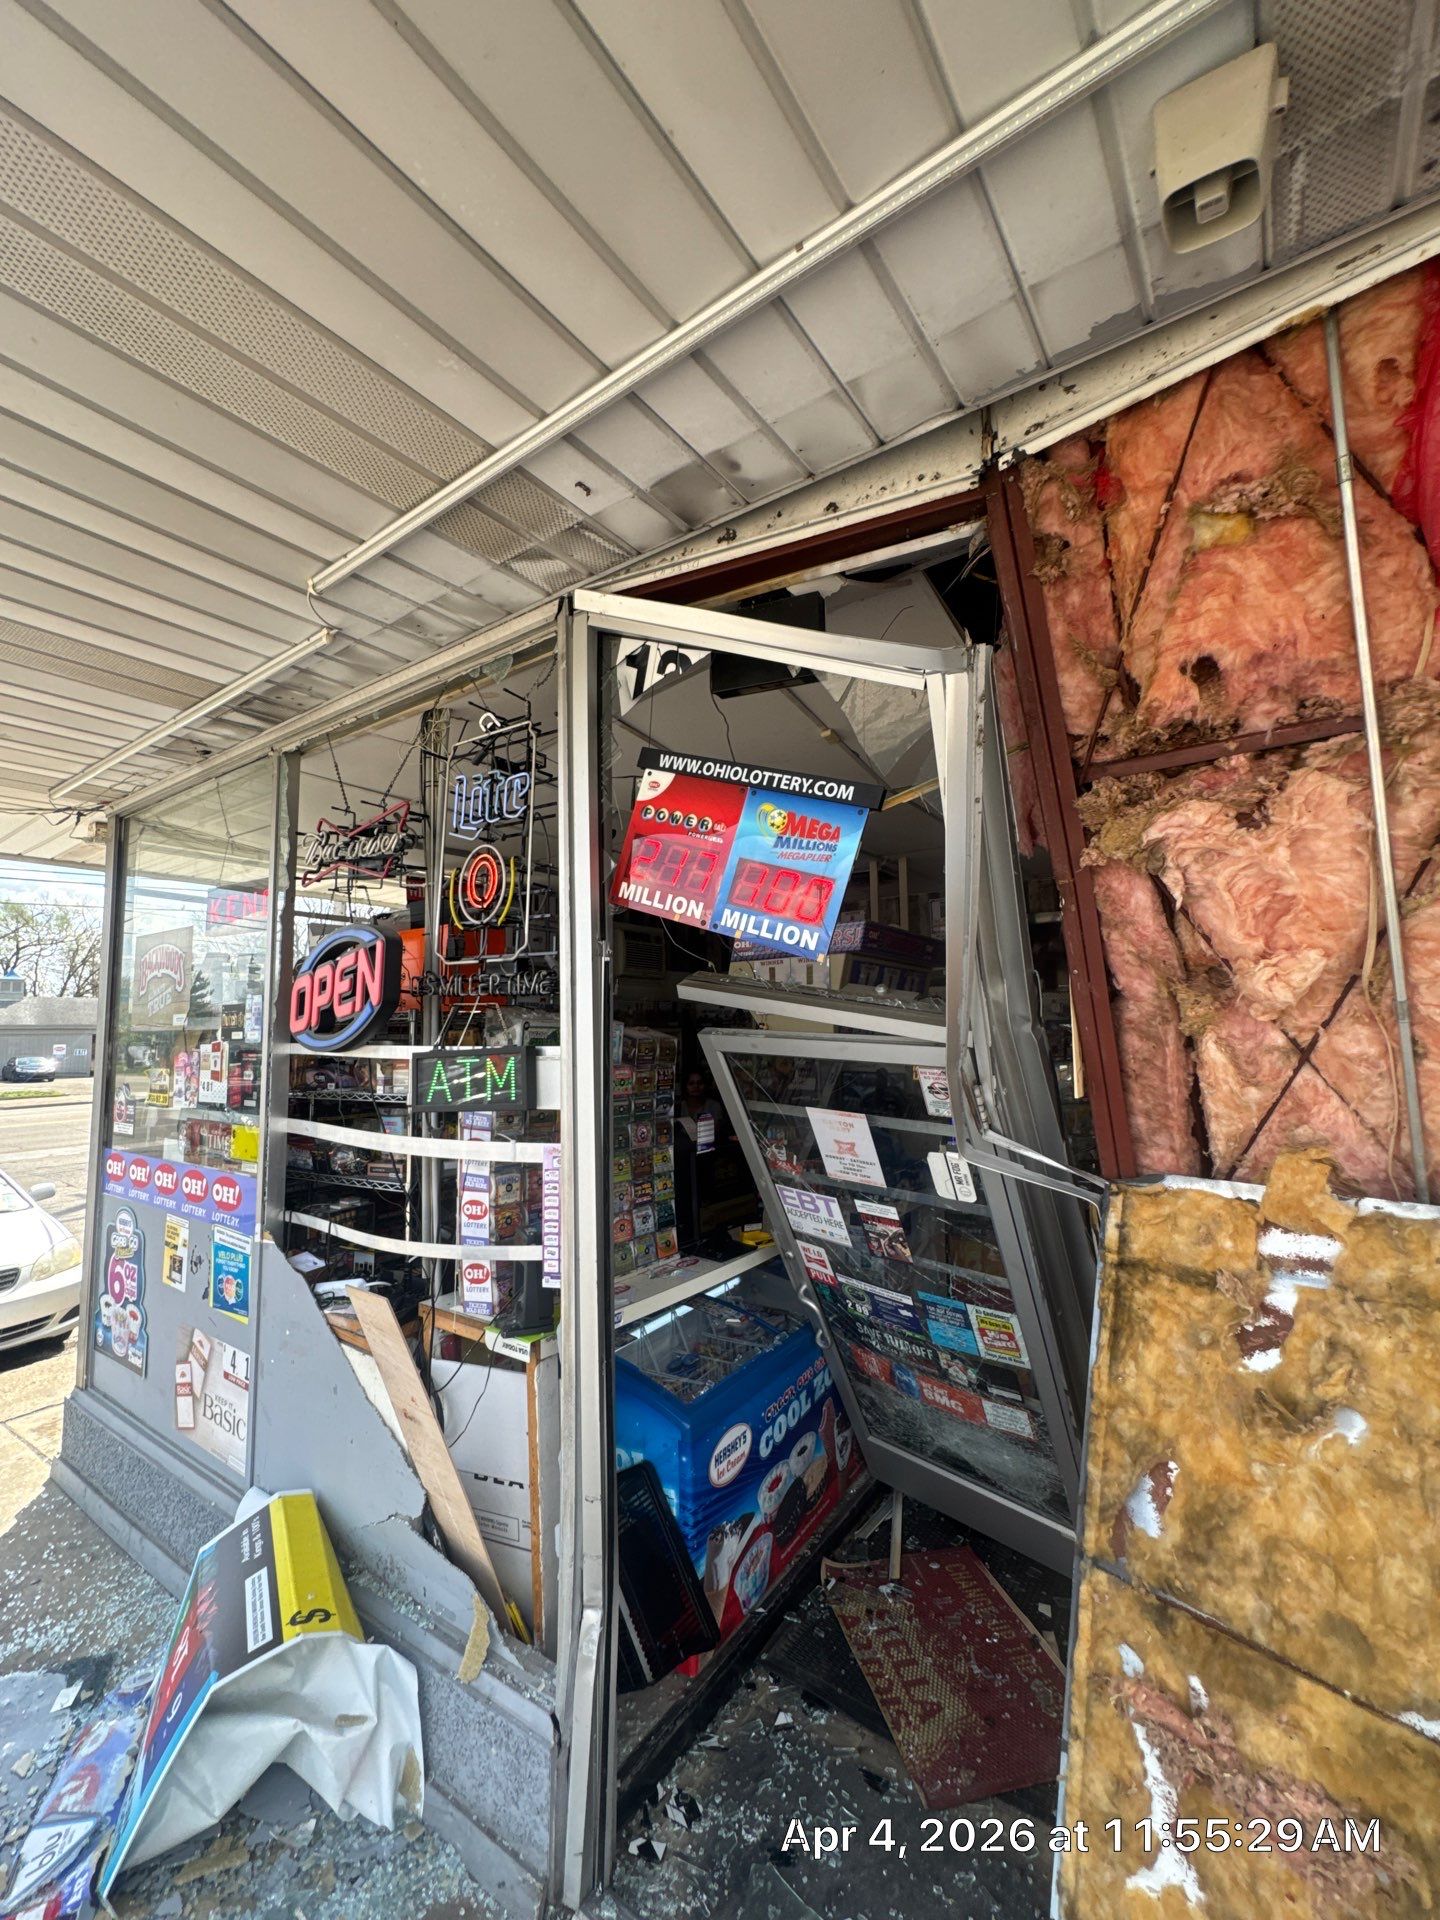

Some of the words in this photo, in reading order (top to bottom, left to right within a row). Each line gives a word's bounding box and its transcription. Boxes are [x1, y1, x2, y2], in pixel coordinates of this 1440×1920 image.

[659, 754, 854, 800] WWW.OHIOLOTTERY.COM
[449, 769, 531, 838] Lite
[782, 811, 841, 841] MEGA
[773, 836, 838, 852] MILLIONS
[777, 851, 833, 863] MEGAPLIER
[618, 881, 704, 920] MILLION
[720, 908, 820, 951] MILLION
[289, 940, 384, 1034] OPEN
[439, 973, 500, 997] MILLER
[504, 970, 552, 996] TIME
[426, 1056, 516, 1103] ATM
[107, 1158, 125, 1176] OH!
[130, 1165, 150, 1182] OH!
[951, 1162, 962, 1176] FOG
[154, 1170, 177, 1189] OH!
[182, 1176, 207, 1196] OH!
[212, 1184, 240, 1205] OH!
[778, 1185, 838, 1218] EBT
[463, 1203, 487, 1216] OH!
[787, 1208, 823, 1224] ACCEPTED
[823, 1217, 845, 1230] HERE
[109, 1252, 125, 1304] 6
[124, 1264, 136, 1283] OZ
[464, 1267, 488, 1280] OH!
[810, 1268, 834, 1285] PULL
[982, 1336, 1017, 1349] Card
[984, 1329, 1010, 1341] We
[214, 1393, 228, 1407] KEEP
[202, 1393, 246, 1442] Basic
[759, 1390, 812, 1458] COOL
[813, 1367, 833, 1400] ZO
[714, 1429, 748, 1468] HERSHEY'S
[716, 1467, 725, 1481] Ice
[726, 1451, 746, 1472] Cream
